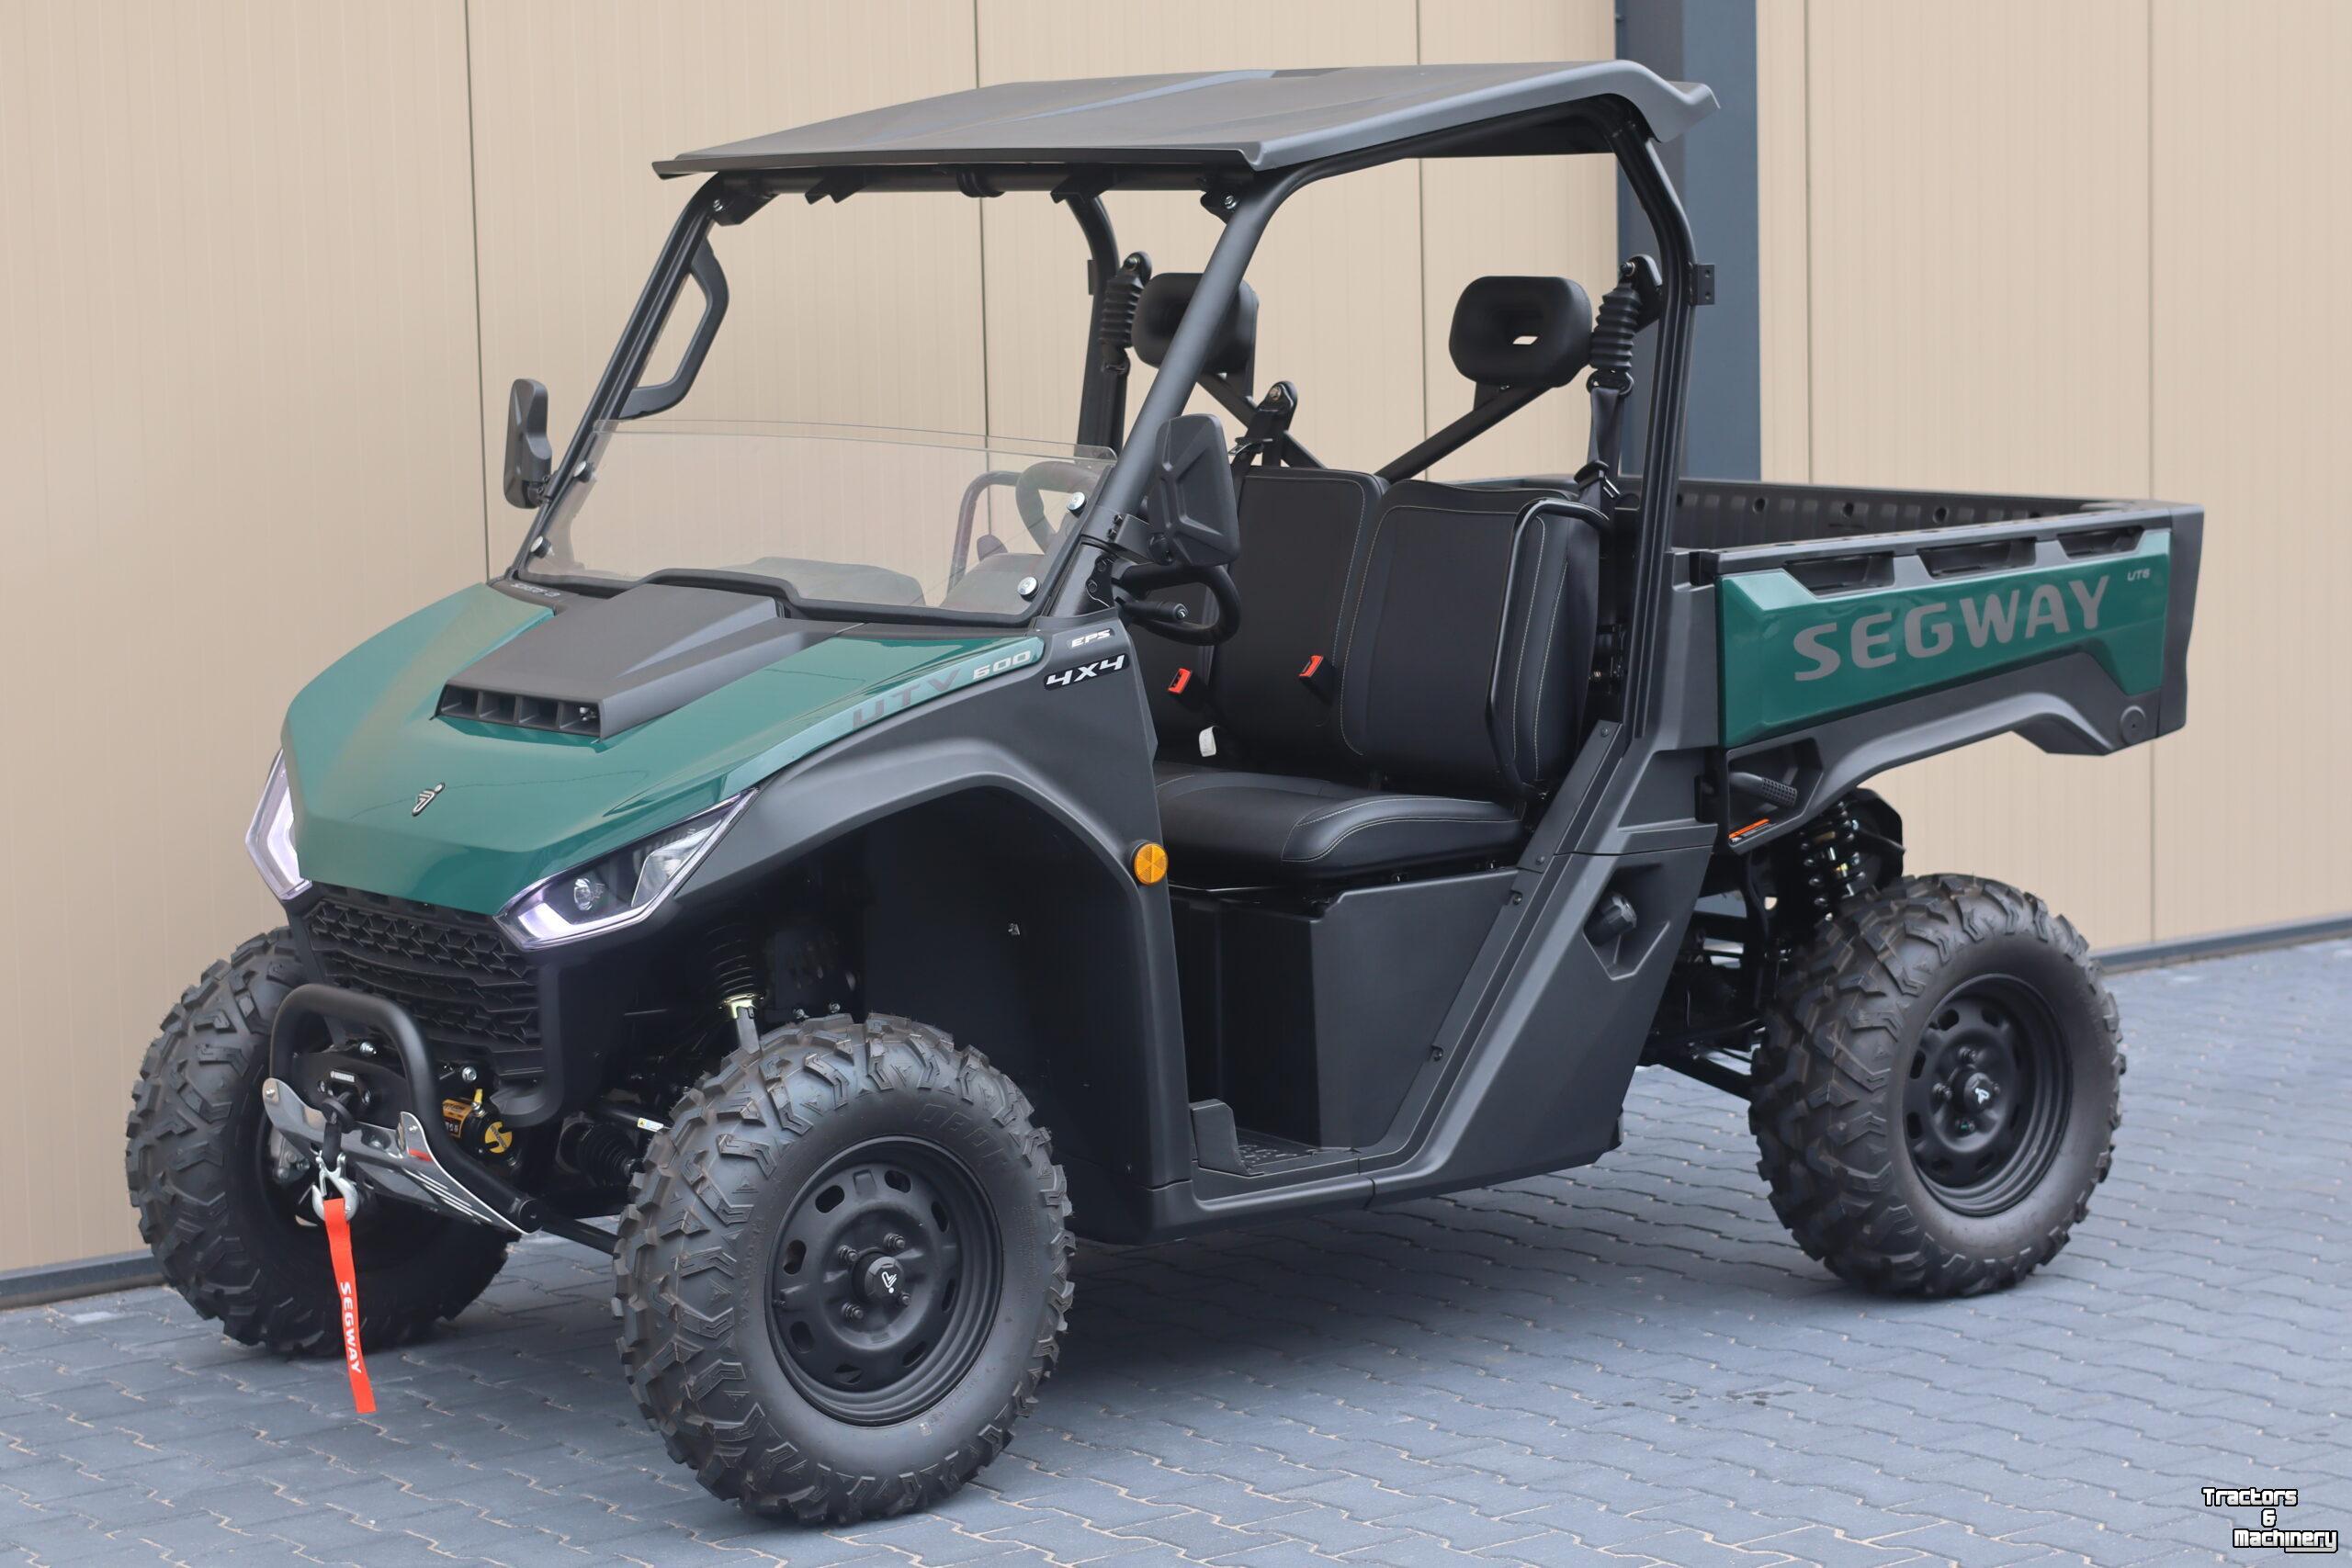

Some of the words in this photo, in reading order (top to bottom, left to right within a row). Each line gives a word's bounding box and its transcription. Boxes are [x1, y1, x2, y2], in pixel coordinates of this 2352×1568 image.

[1071, 628, 1111, 649] EPS
[1793, 574, 2110, 682] SEGWAY
[853, 668, 961, 729] UTV
[972, 650, 1032, 680] 600
[340, 1281, 362, 1374] SEGWAY
